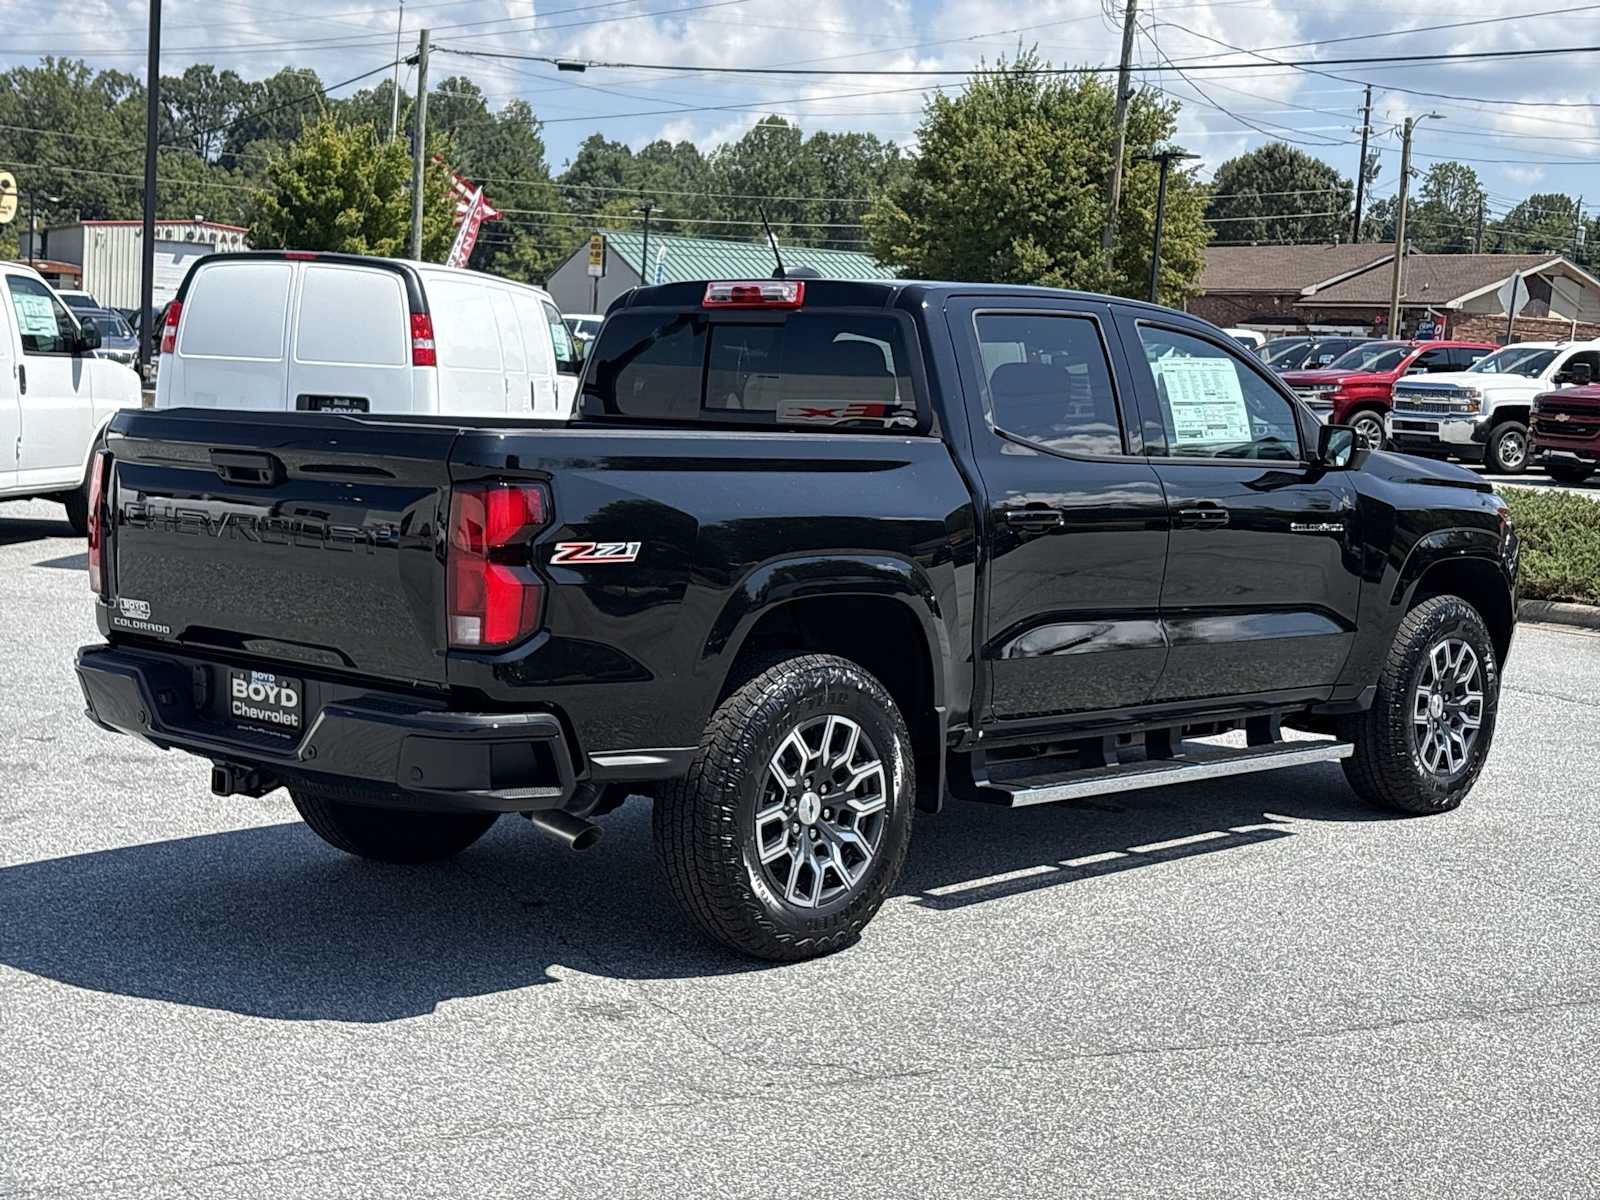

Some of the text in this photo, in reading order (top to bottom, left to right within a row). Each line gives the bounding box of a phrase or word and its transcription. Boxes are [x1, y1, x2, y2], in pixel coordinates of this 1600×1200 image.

[124, 502, 388, 555] CHEVROLET
[550, 542, 641, 564] Z71
[114, 617, 170, 634] COLORADO
[251, 671, 275, 681] BOYD
[232, 678, 298, 707] BOYD
[232, 701, 298, 726] Chevrolet
